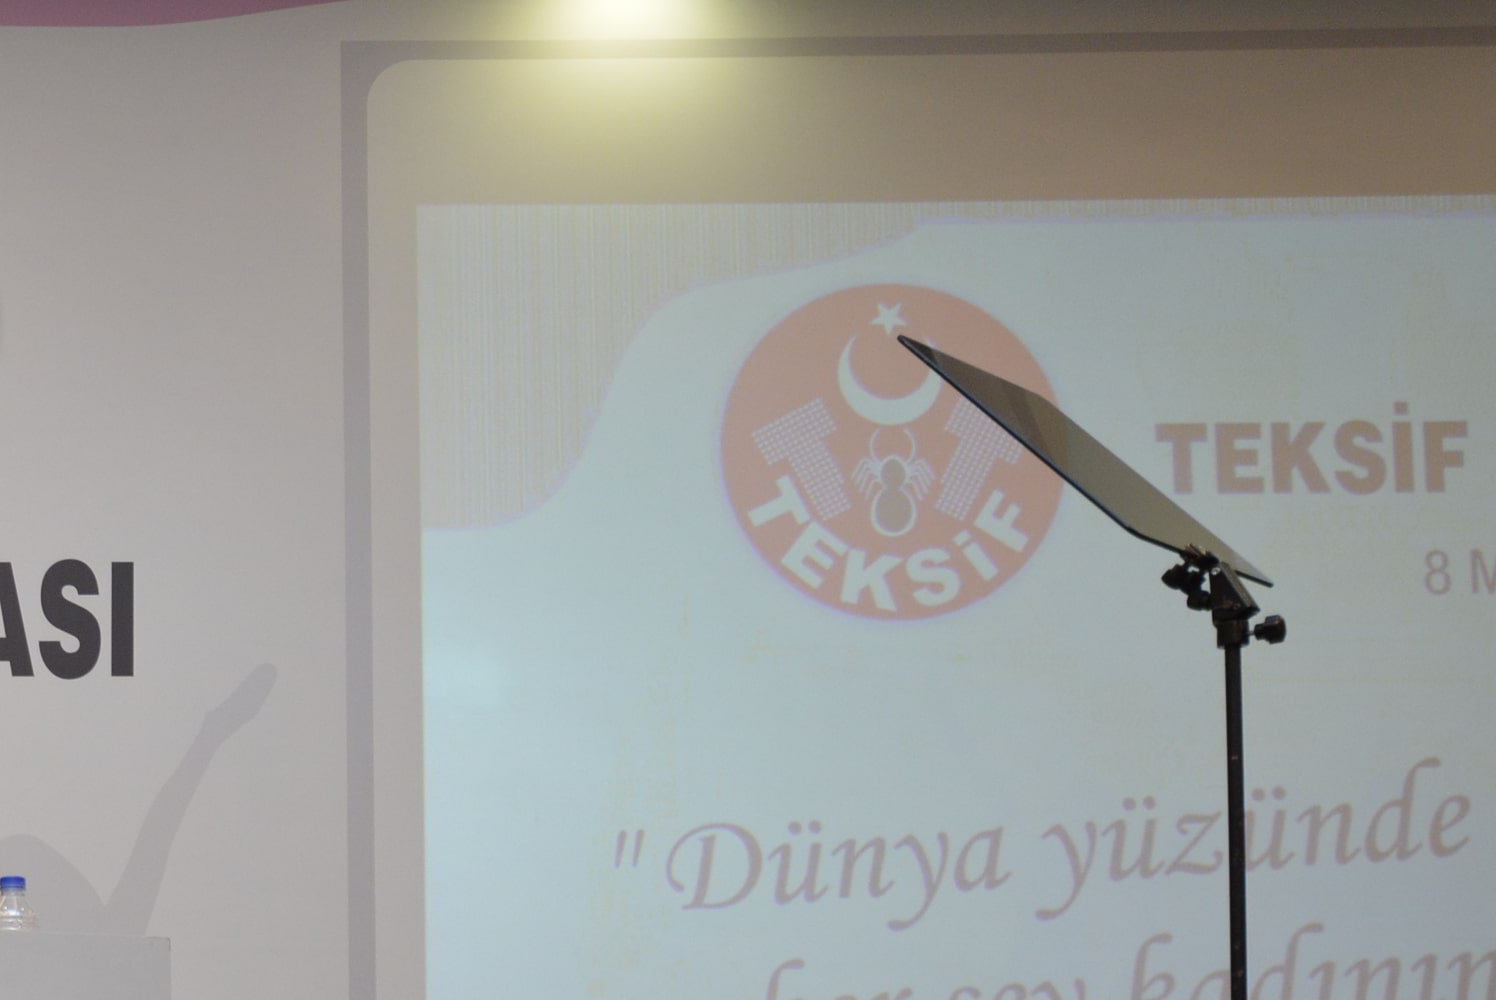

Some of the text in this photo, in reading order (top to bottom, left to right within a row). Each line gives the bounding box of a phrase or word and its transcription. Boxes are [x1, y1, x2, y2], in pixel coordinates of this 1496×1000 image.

[1155, 401, 1469, 495] TEKSİF
[1423, 549, 1451, 596] 8
[1034, 757, 1472, 922] yüzünde
